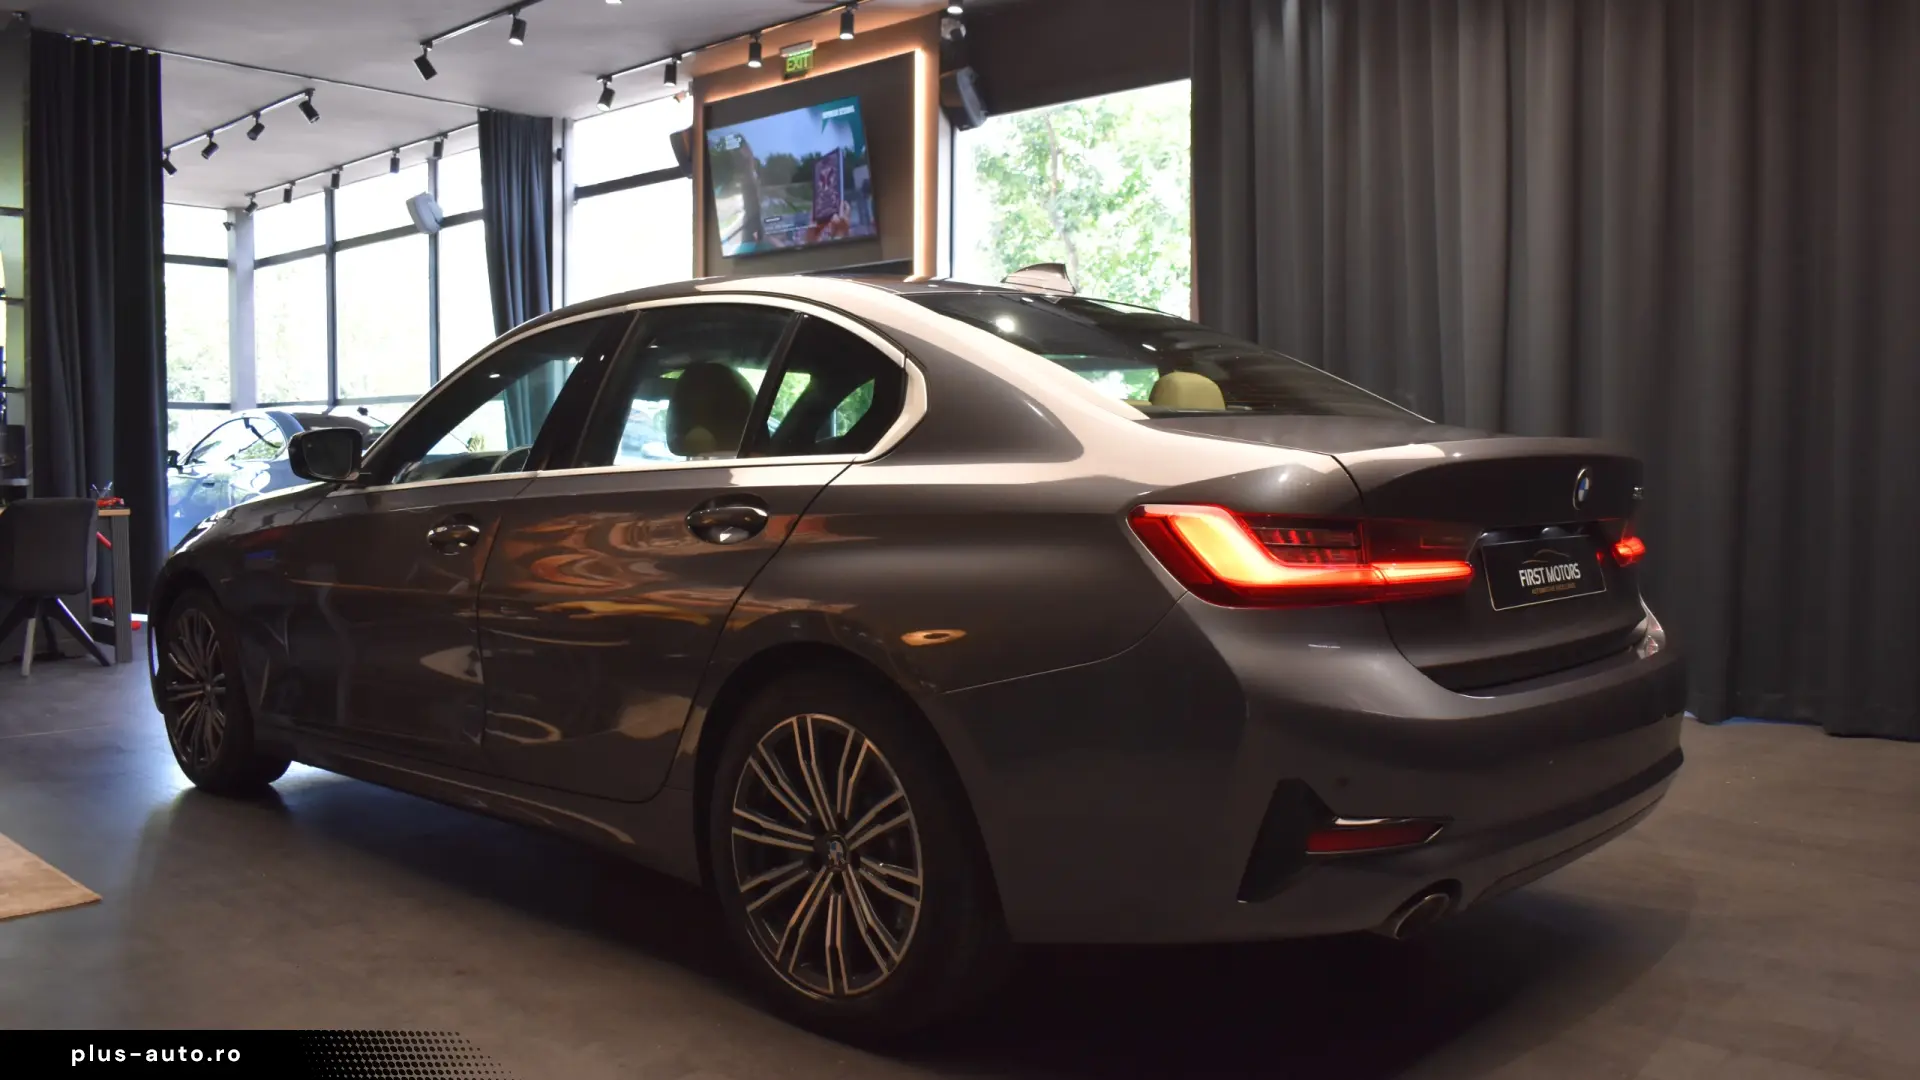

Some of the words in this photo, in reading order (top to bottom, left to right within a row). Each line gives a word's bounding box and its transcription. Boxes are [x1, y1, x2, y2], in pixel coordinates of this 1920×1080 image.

[786, 54, 809, 73] EXIT
[1518, 567, 1546, 587] FIRST
[1545, 563, 1581, 583] MOTORS
